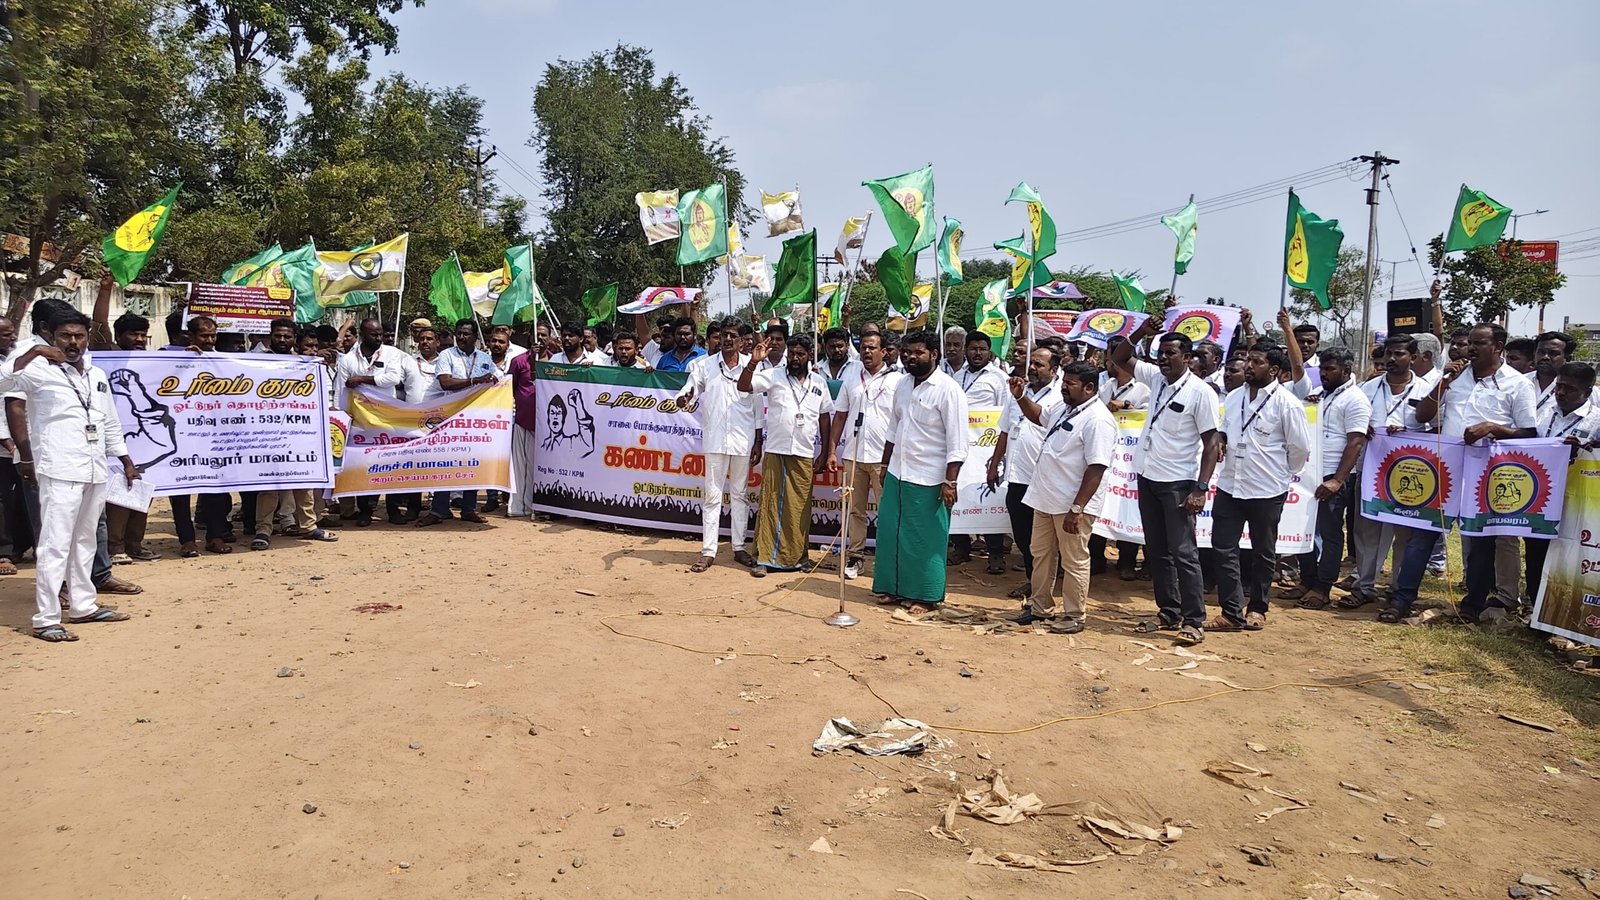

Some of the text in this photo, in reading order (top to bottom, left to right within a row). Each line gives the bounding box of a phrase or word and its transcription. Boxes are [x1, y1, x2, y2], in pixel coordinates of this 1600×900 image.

[157, 372, 316, 400] உரிமை குரல்
[173, 400, 318, 413] ஓட்டுநர் தொழிற்சங்கம்
[595, 390, 656, 410] உரிமை
[188, 415, 217, 426] பதிவு
[221, 414, 246, 424] எண்
[258, 414, 311, 424] 532/KPM
[170, 451, 317, 469] அரியலூர் மாவட்டம்
[368, 458, 479, 474] திருச்சி மாவட்டம்
[538, 466, 546, 475] Reg
[558, 468, 568, 476] 532
[572, 469, 584, 478] KPM
[370, 475, 394, 484] அறம்
[633, 482, 702, 498] ஓட்டுநர்களாய்
[962, 505, 982, 515] எண்
